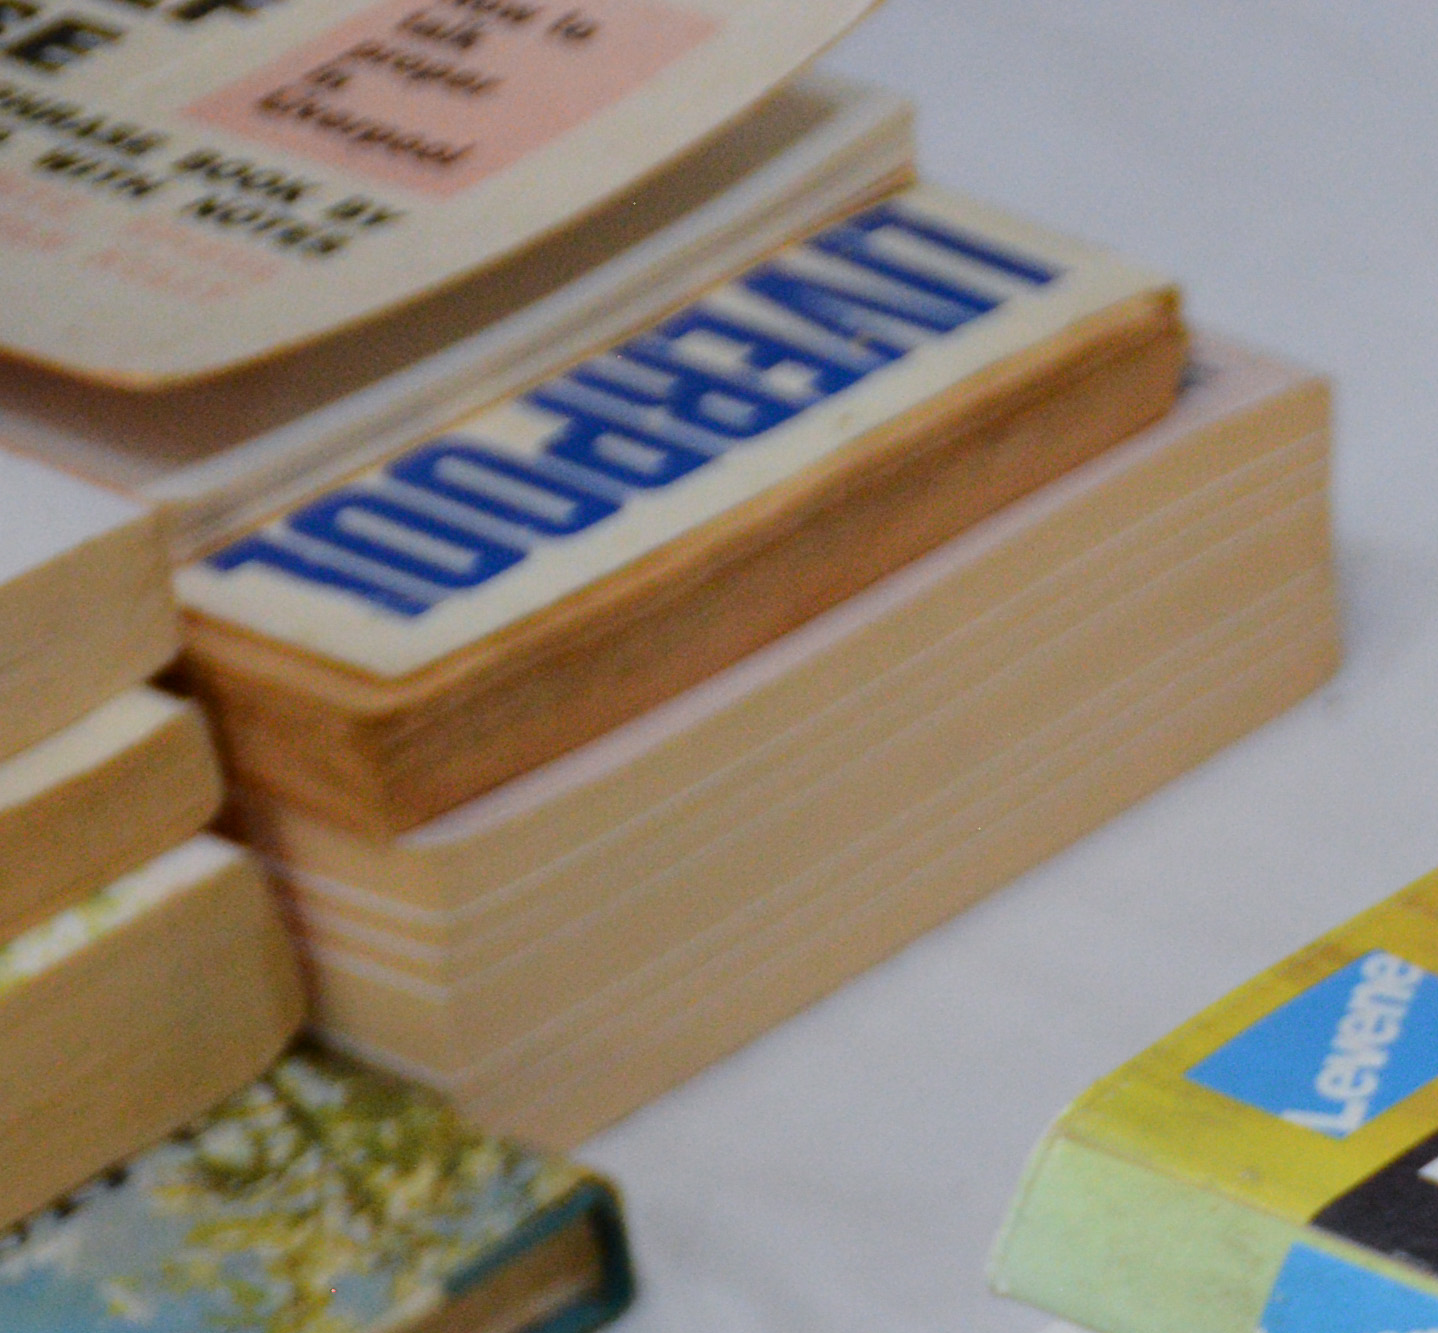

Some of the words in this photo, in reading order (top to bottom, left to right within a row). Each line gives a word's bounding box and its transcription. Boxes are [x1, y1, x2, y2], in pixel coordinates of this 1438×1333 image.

[257, 86, 475, 165] Liverpool
[34, 148, 164, 197] WITH
[183, 195, 350, 257] NOTES
[172, 147, 315, 204] BOOK
[322, 196, 406, 227] BY
[203, 200, 1066, 620] LIVERPOOL
[1279, 949, 1425, 1138] Levene
